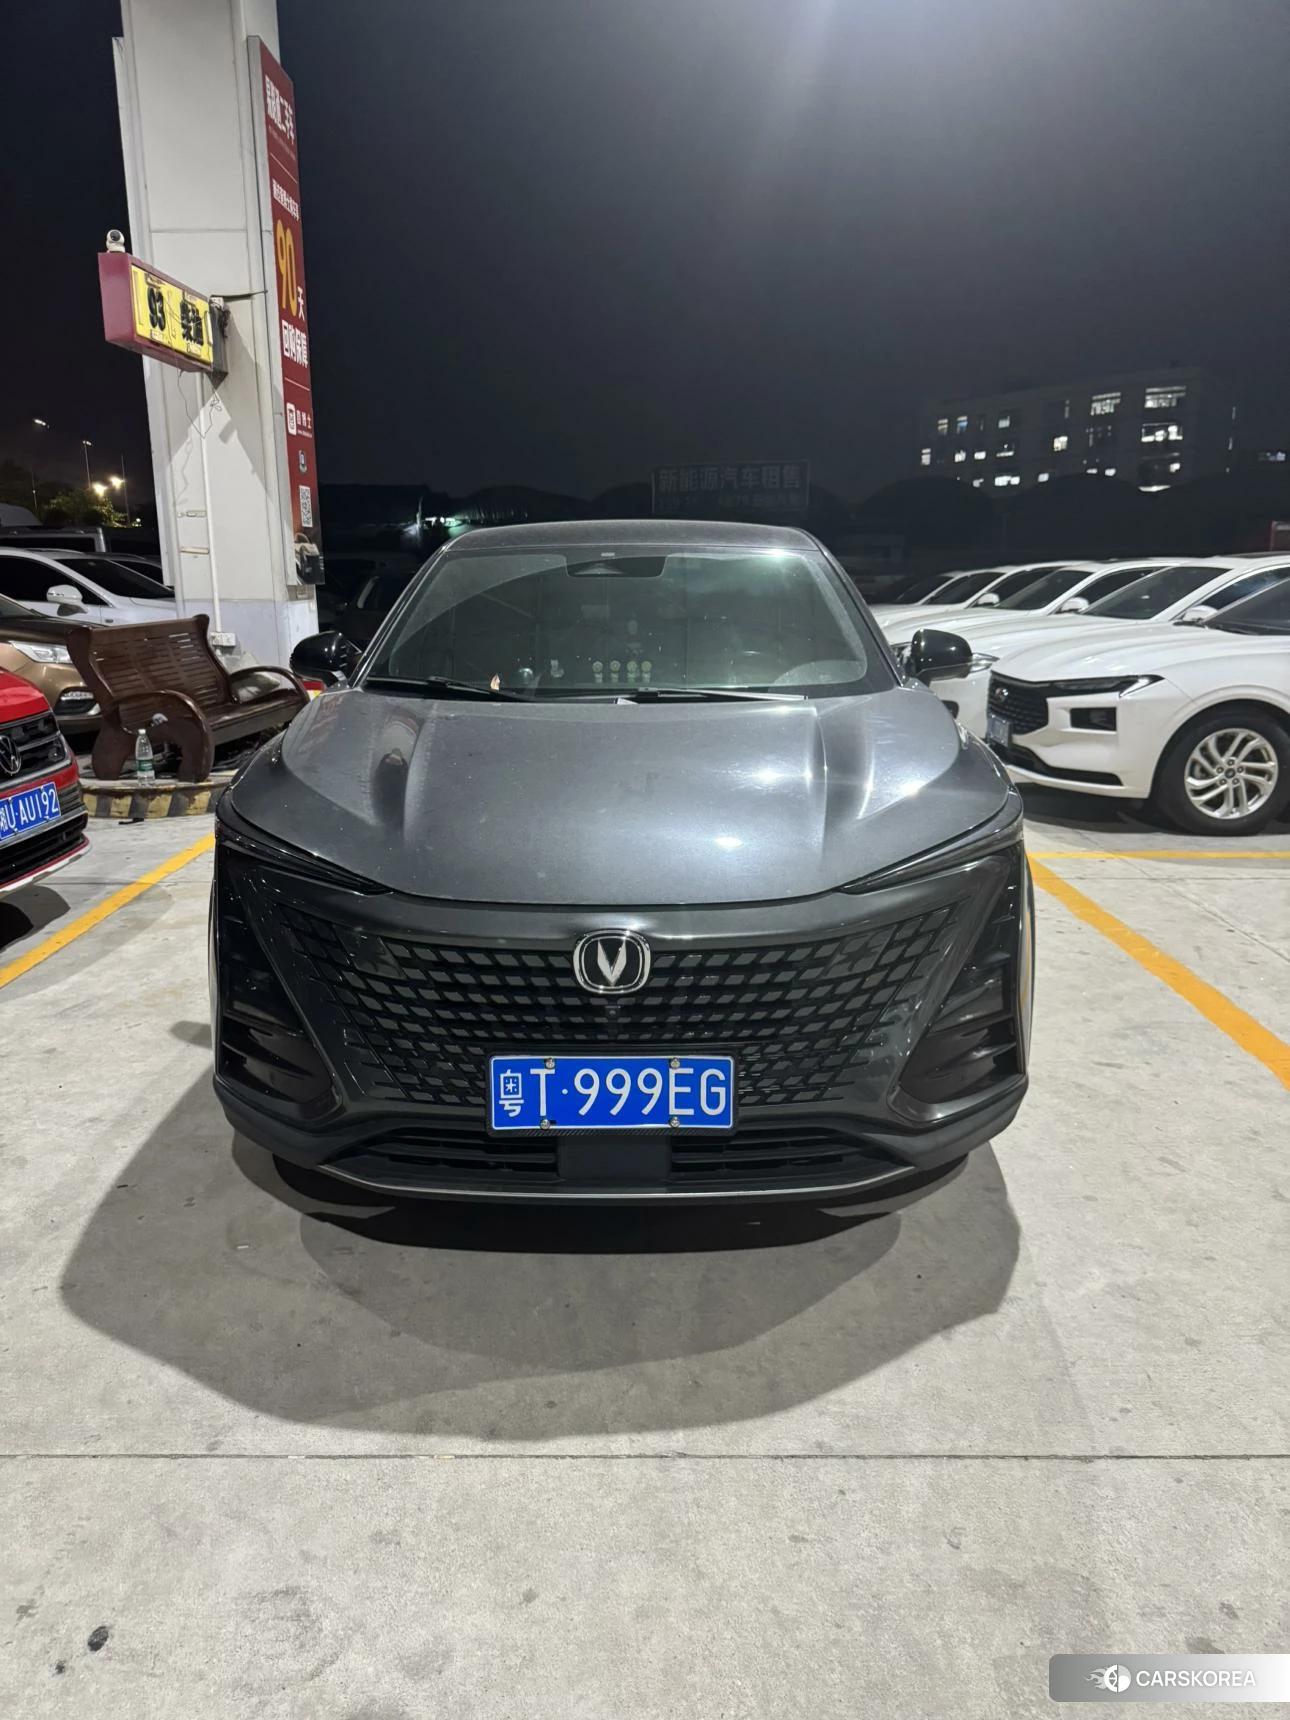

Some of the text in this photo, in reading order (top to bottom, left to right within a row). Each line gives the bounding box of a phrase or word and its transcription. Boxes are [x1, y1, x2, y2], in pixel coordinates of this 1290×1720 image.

[658, 464, 802, 492] 新能源汽车租售
[498, 1068, 727, 1118] 粤T·999EG
